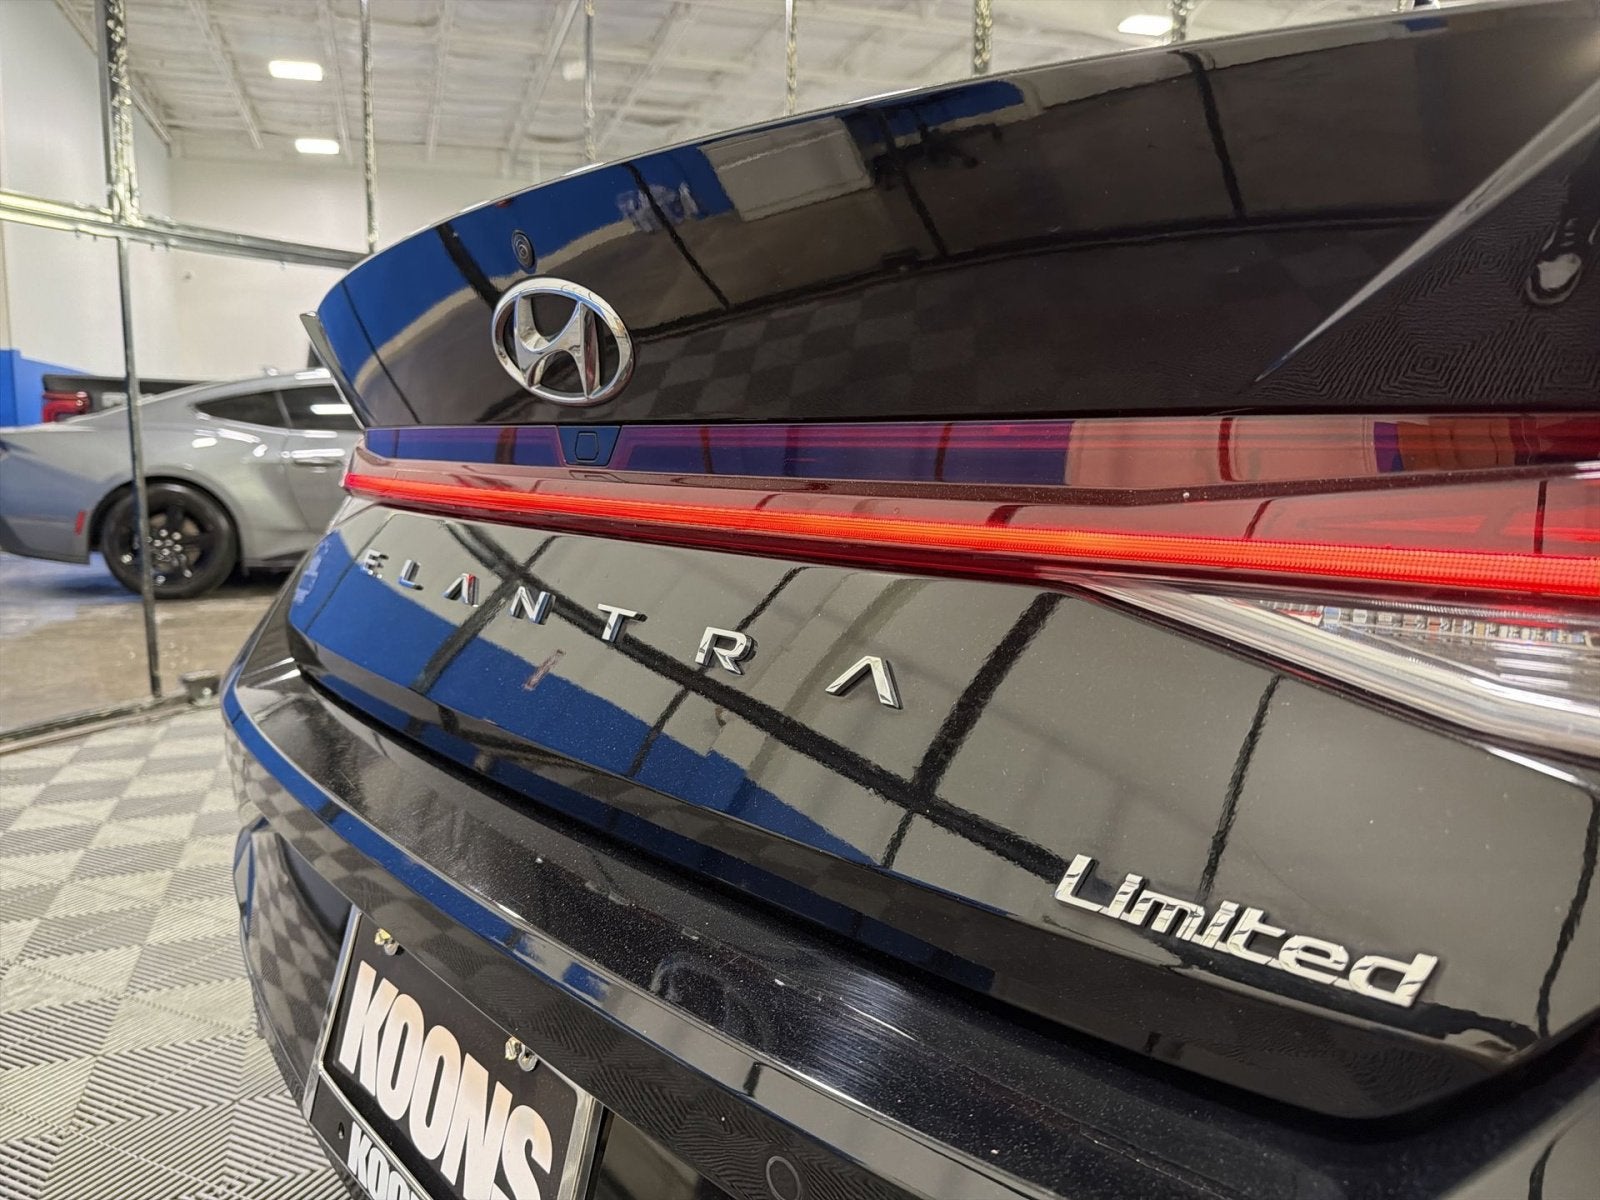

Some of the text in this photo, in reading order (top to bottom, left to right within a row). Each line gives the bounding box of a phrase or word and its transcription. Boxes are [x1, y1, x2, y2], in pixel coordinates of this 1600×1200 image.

[361, 548, 902, 710] ELANTRA
[1054, 853, 1439, 1008] Limited
[338, 959, 553, 1200] KOONS
